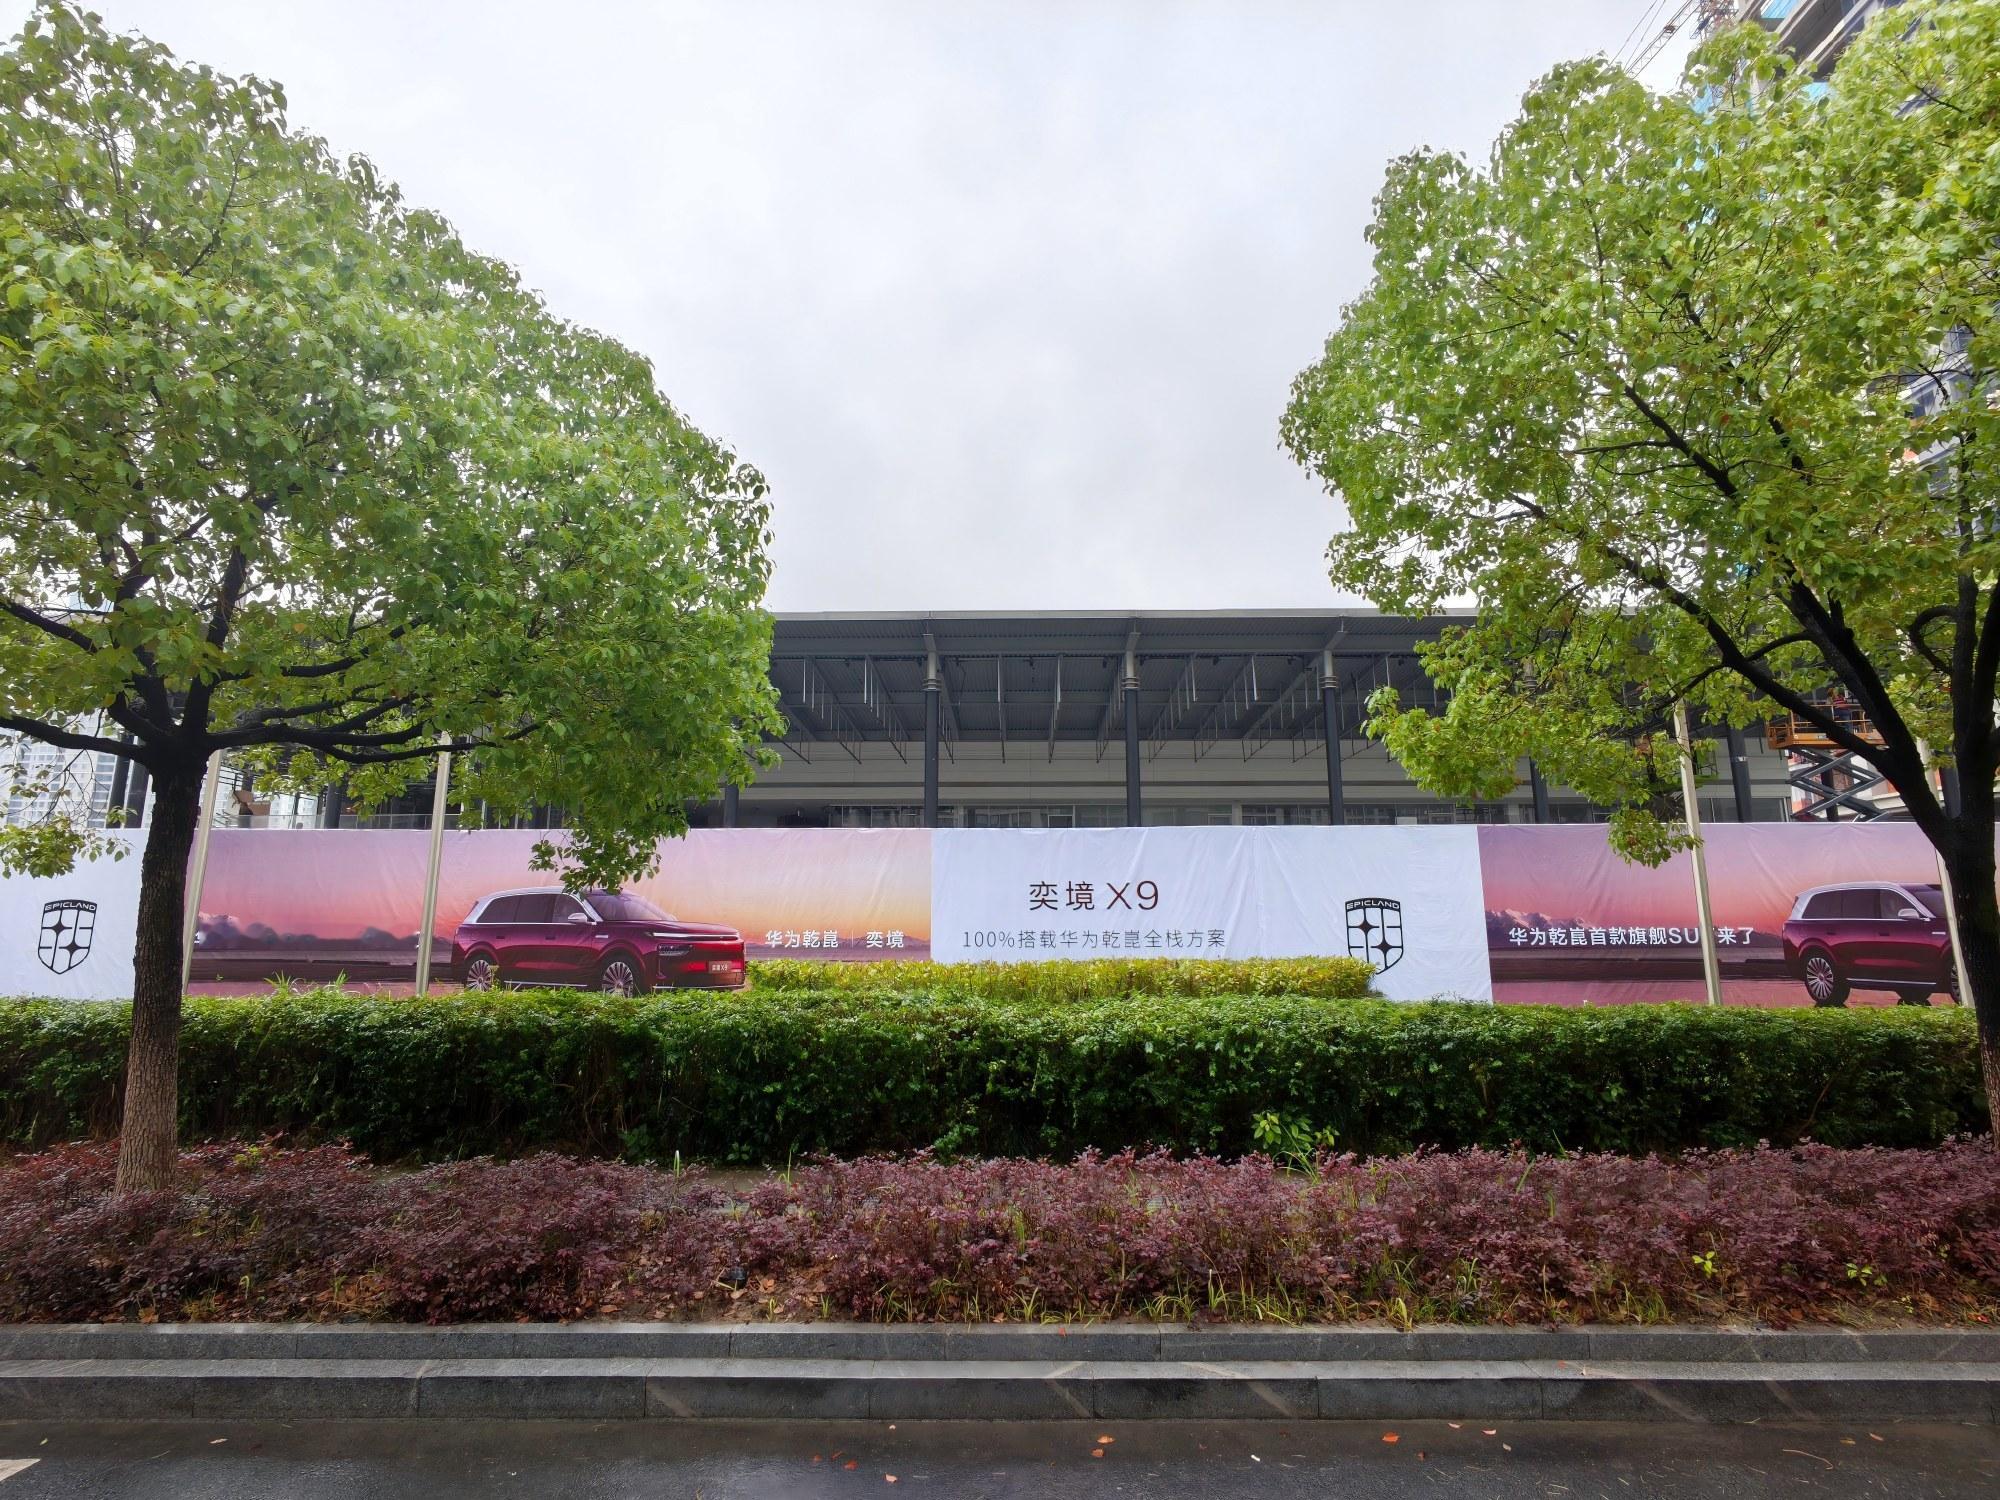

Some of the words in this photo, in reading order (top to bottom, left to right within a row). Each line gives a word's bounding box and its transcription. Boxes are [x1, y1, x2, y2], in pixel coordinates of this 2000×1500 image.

[45, 901, 96, 911] EPICLAND
[1346, 899, 1400, 910] EPICLAND
[765, 930, 839, 949] 华为乾崑
[866, 930, 905, 949] 奕境
[1509, 926, 1755, 946] 华为乾崑首款旗舰SU来了
